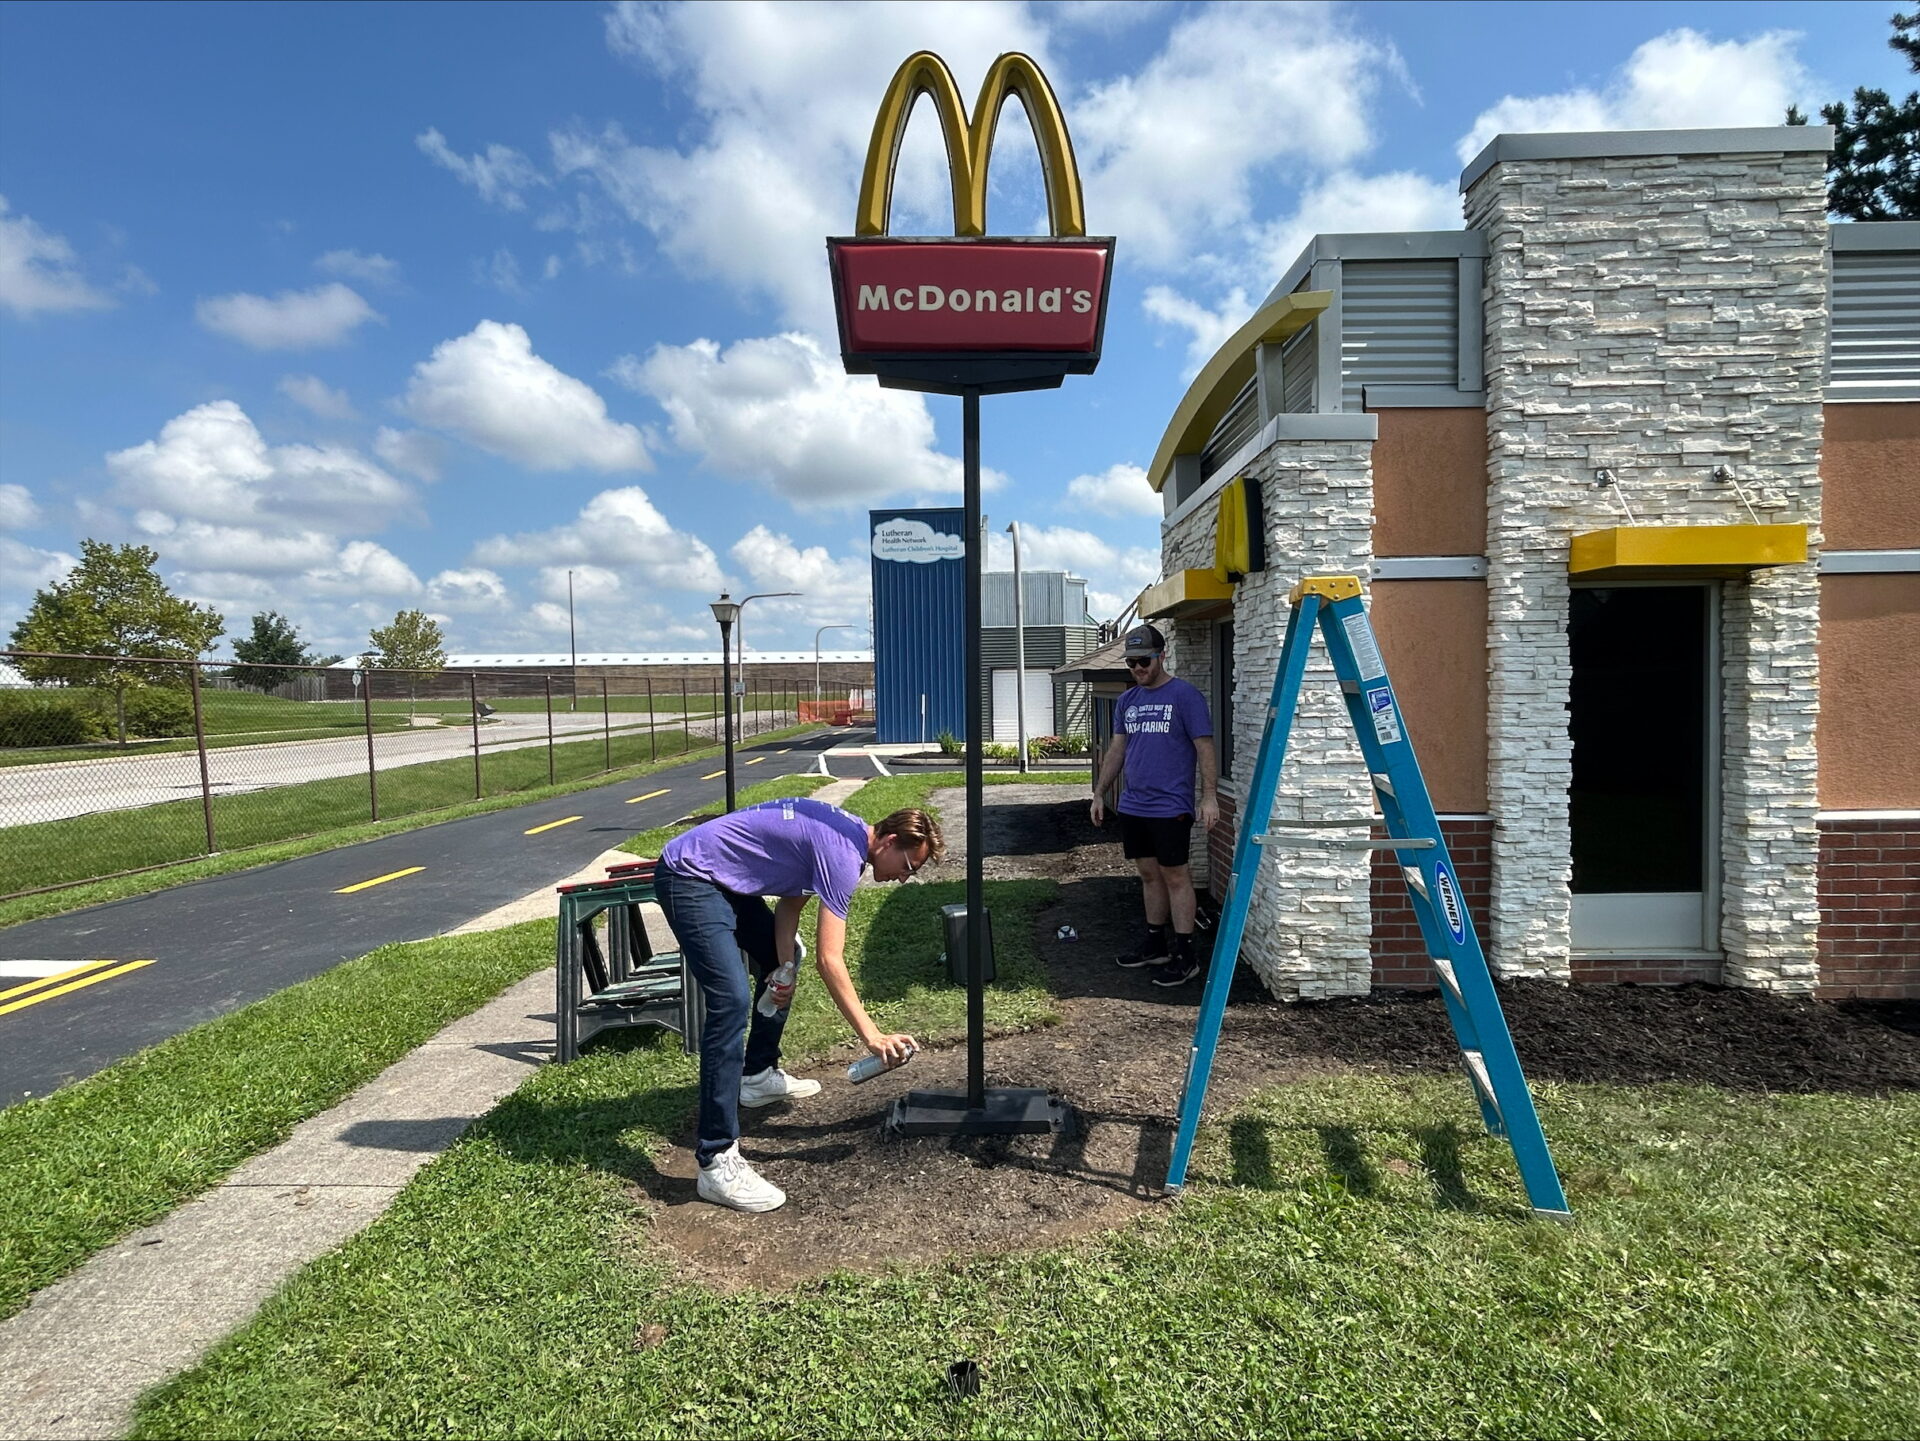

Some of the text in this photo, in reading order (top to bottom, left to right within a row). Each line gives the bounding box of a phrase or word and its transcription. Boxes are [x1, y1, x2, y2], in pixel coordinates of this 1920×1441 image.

[857, 285, 1092, 313] McDonald's
[935, 544, 958, 552] Hospital
[1141, 722, 1169, 733] CARING
[1440, 877, 1460, 927] WERNER
